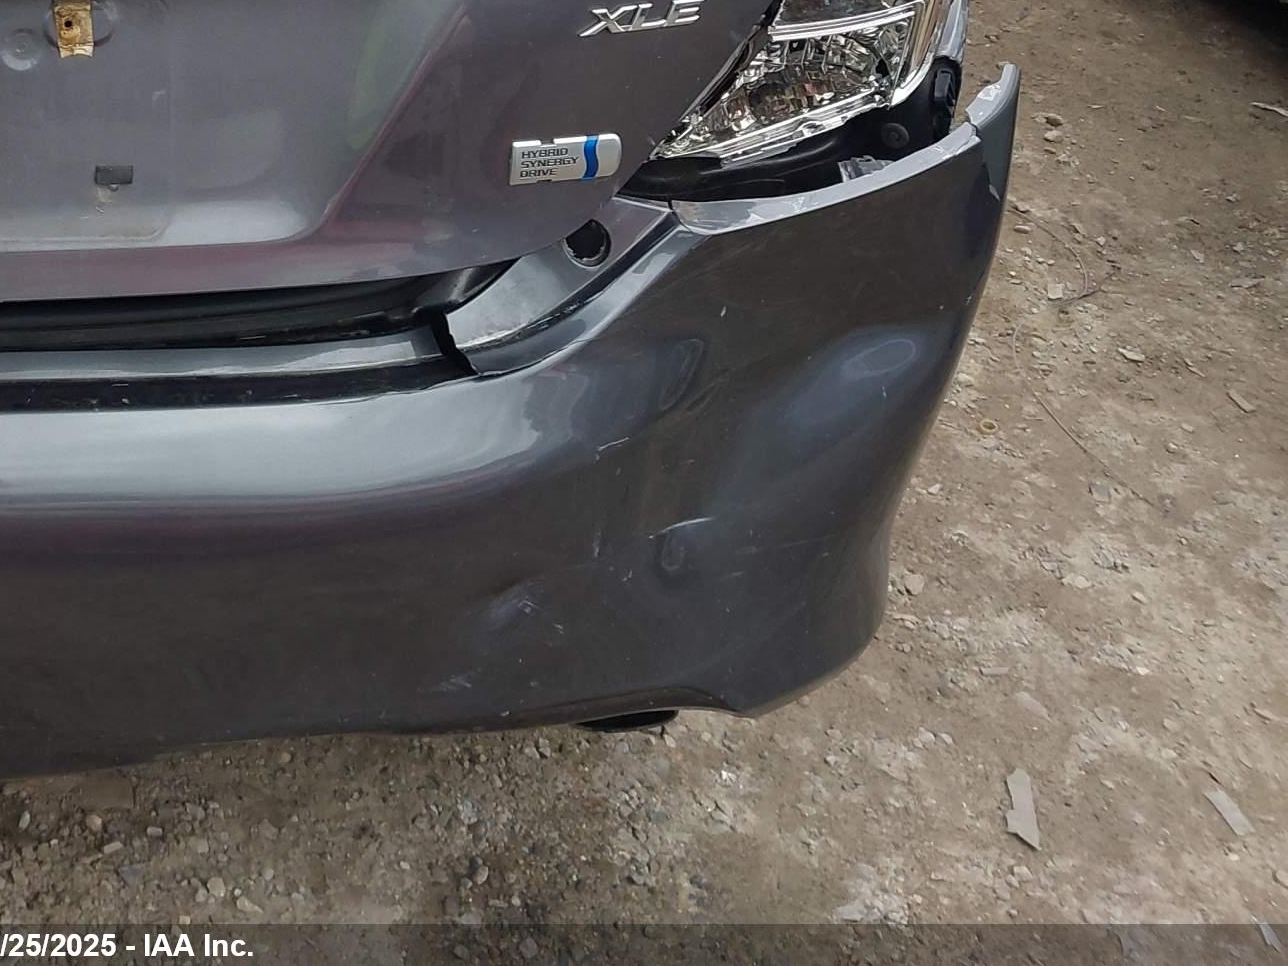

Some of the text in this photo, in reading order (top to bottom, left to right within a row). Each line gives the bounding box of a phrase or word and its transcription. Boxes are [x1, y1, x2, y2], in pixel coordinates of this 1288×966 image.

[521, 147, 568, 159] HYBRID
[520, 156, 579, 168] SYNERGY
[519, 167, 558, 178] DRIVE
